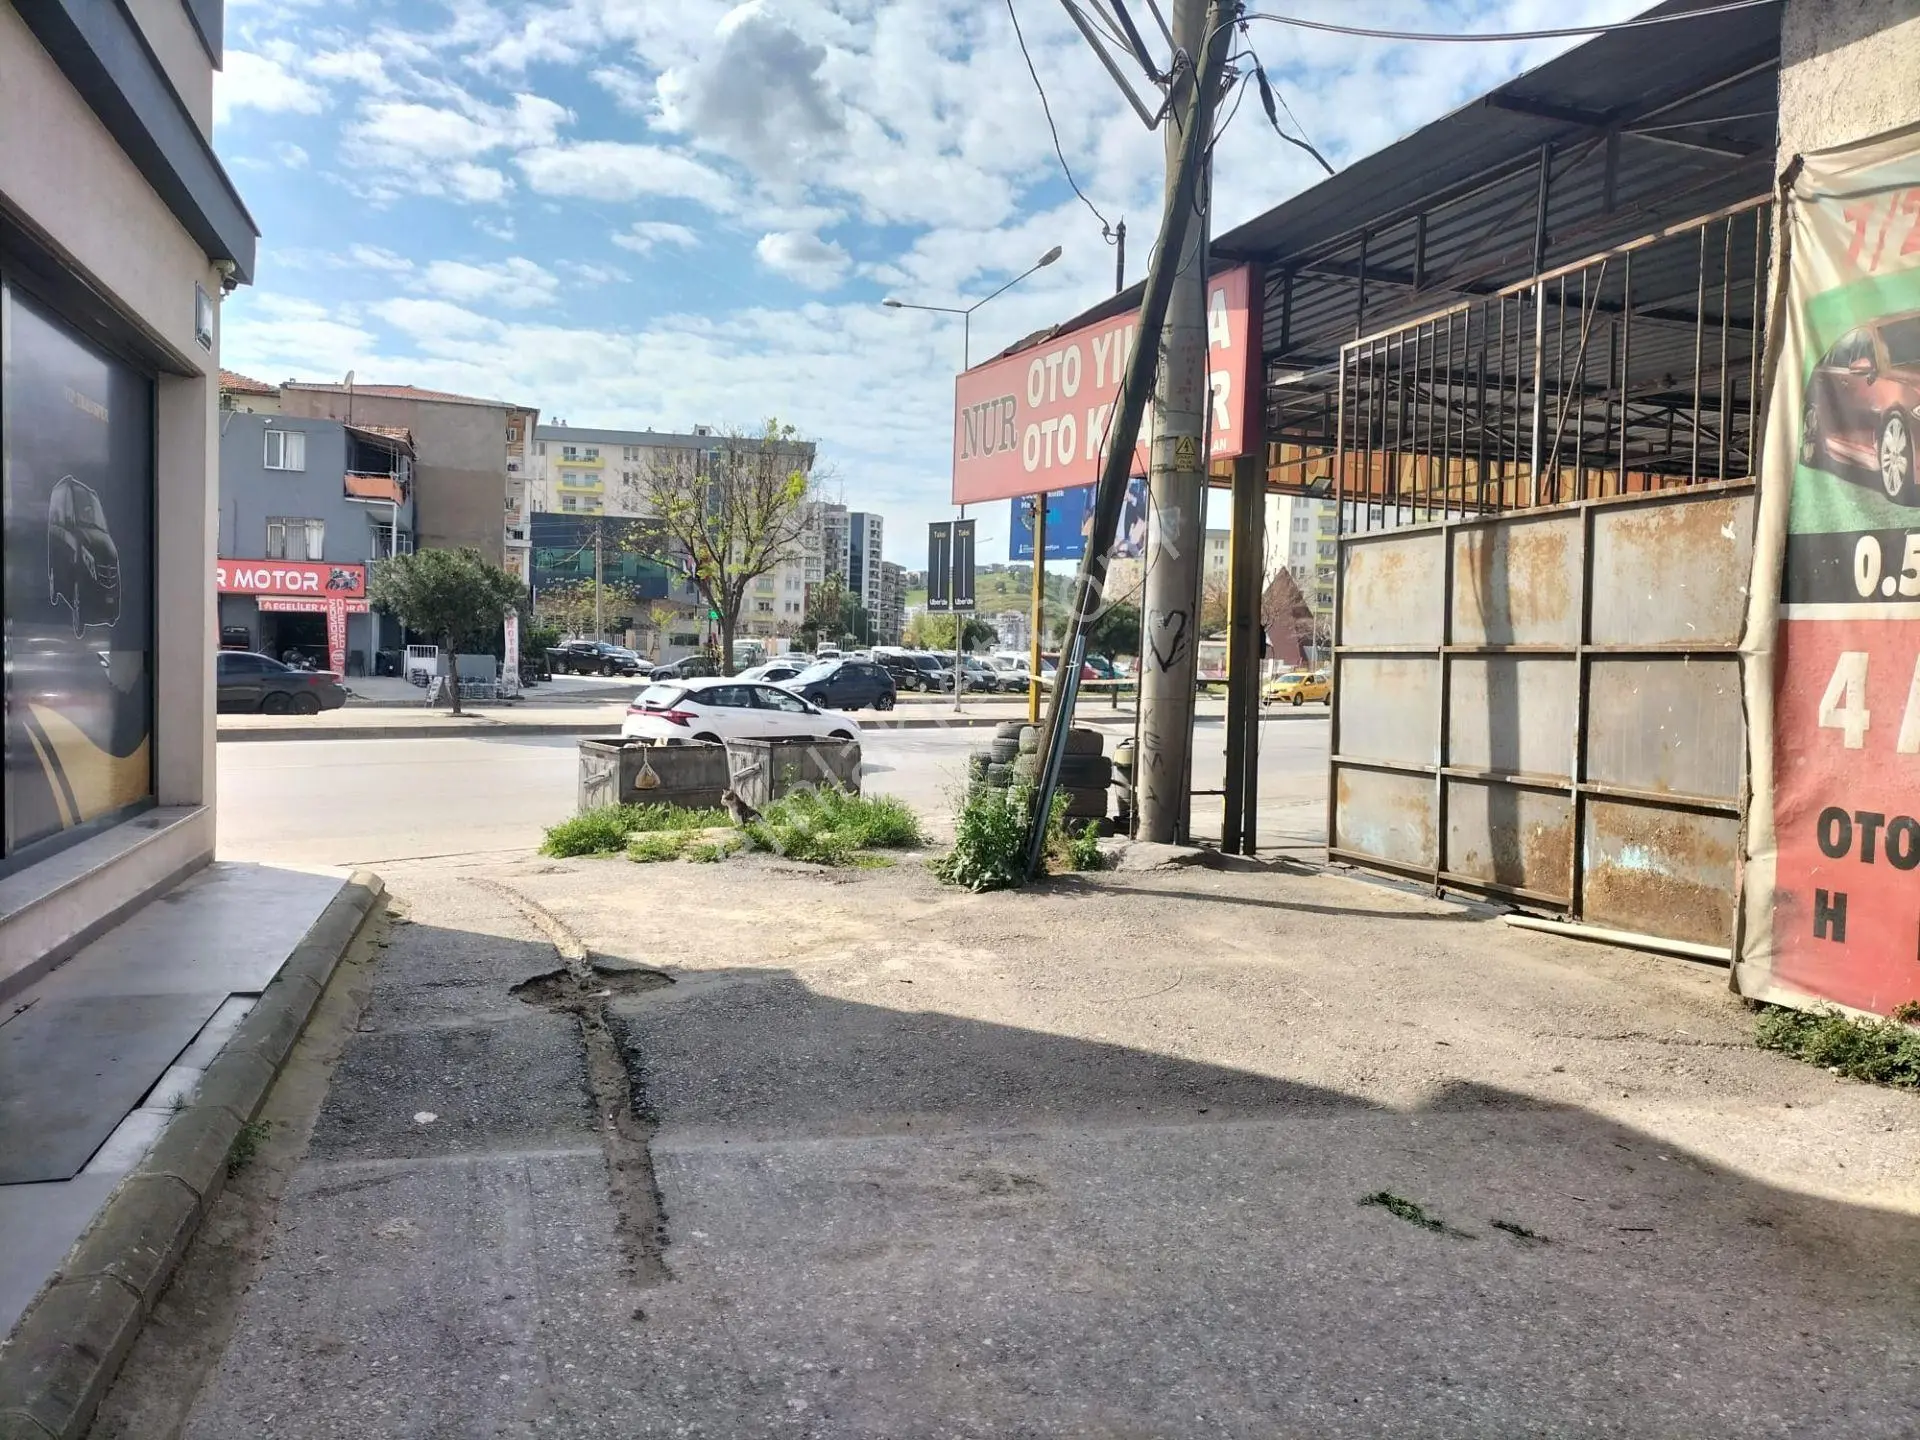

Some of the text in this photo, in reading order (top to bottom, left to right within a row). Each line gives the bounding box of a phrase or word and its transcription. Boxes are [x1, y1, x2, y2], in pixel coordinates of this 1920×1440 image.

[1027, 345, 1081, 408] OTO
[960, 394, 1018, 459] NUR
[1023, 414, 1076, 472] OTO
[233, 567, 318, 591] MOTOR
[1816, 806, 1920, 871] OTO
